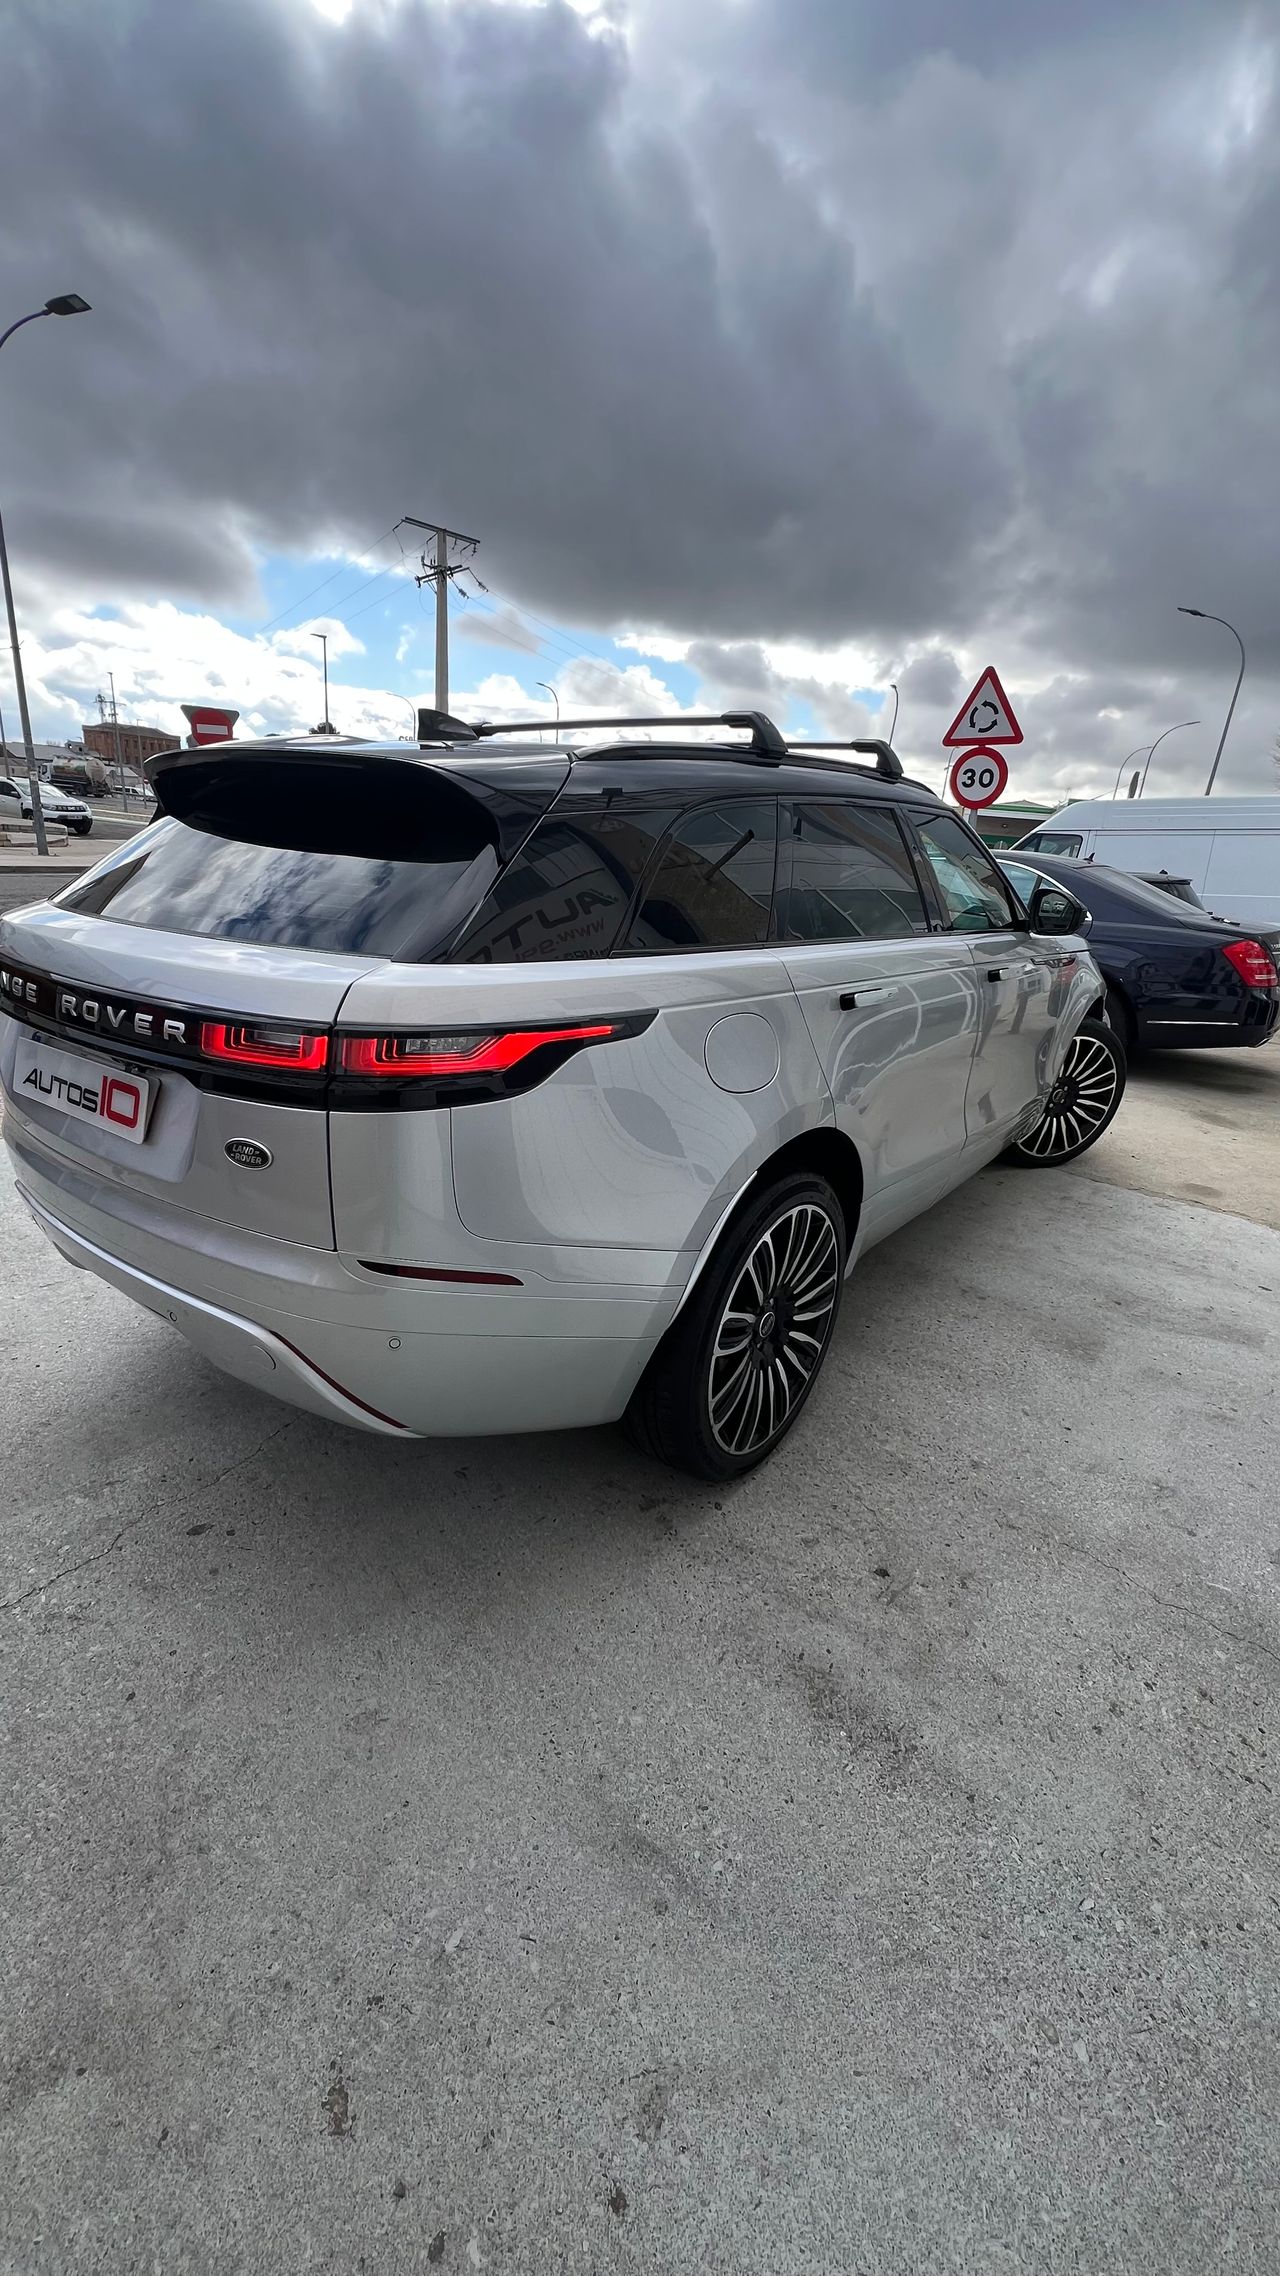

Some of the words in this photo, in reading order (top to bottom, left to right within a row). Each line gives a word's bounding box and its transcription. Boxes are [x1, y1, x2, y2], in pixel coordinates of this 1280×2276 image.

[961, 768, 994, 788] 30
[61, 994, 186, 1044] ROVER
[232, 1144, 254, 1155] LAND
[235, 1152, 262, 1165] ROVER
